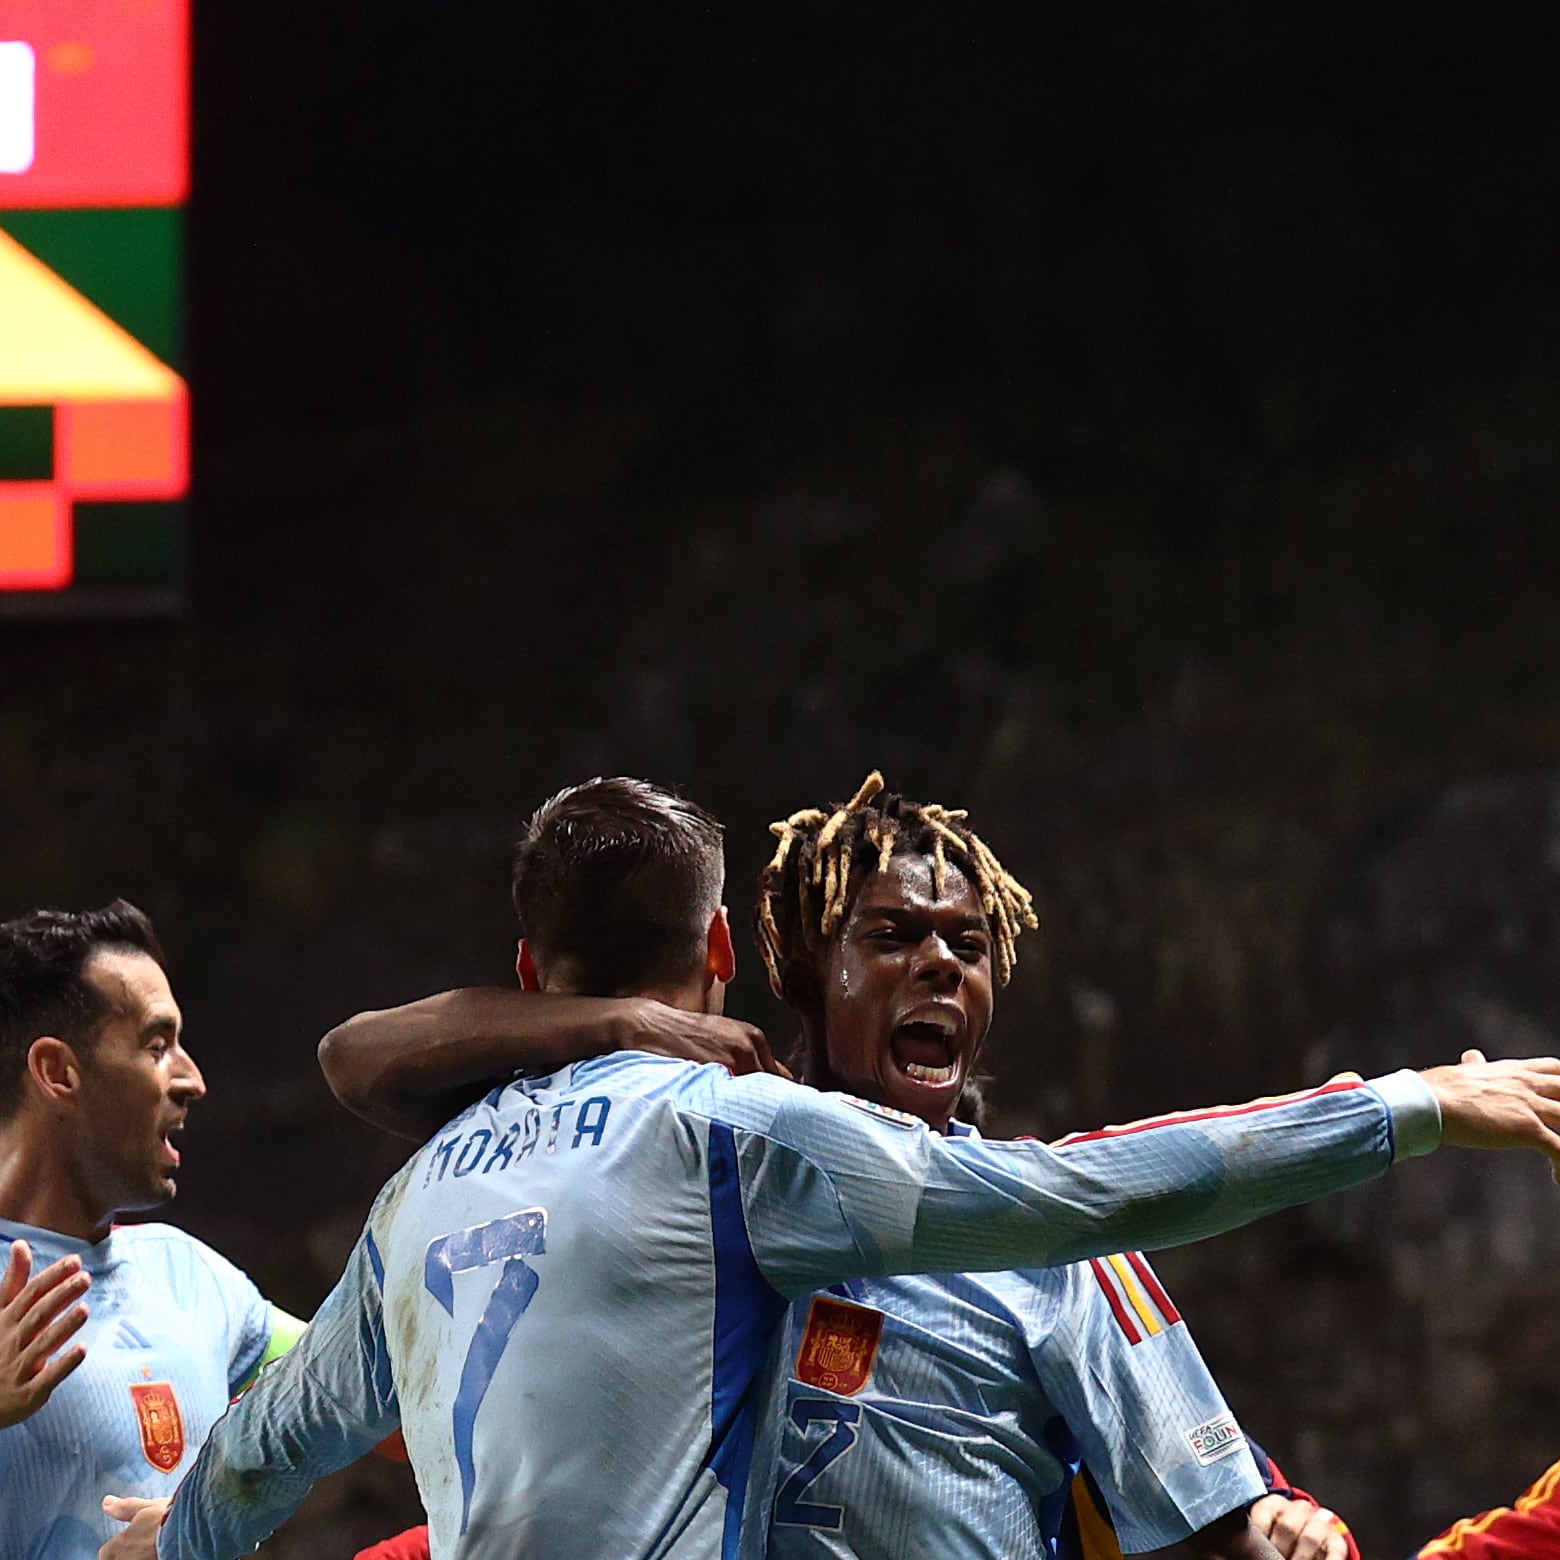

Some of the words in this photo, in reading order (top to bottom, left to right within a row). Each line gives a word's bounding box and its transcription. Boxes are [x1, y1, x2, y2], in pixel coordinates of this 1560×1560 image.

[422, 1095, 613, 1190] MORATA
[423, 1205, 549, 1535] 7
[774, 1396, 864, 1534] 2
